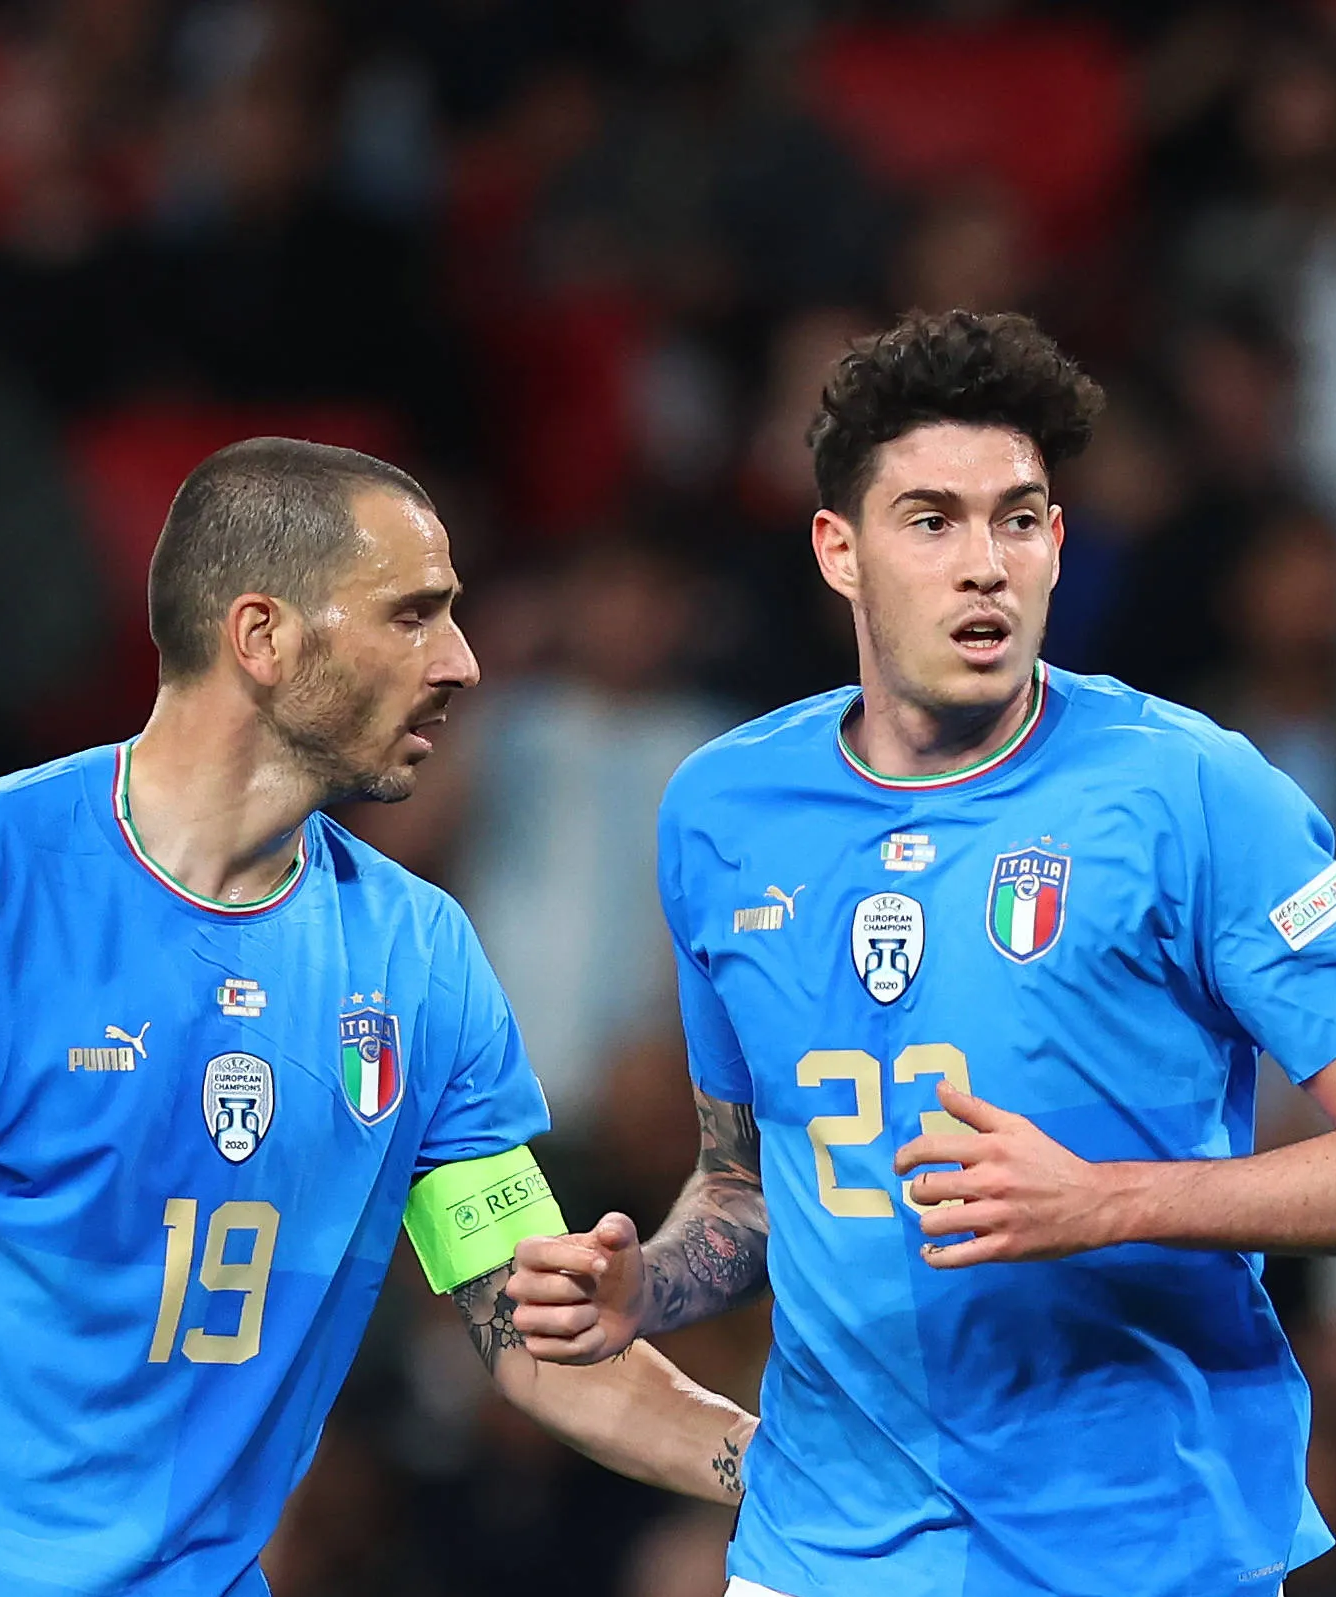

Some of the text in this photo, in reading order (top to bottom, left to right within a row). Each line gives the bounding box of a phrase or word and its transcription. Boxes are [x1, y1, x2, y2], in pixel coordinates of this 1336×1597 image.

[1000, 859, 1062, 879] ITALIA
[733, 904, 784, 934] PUMA
[863, 914, 913, 923] EUROPEAN
[1275, 900, 1300, 923] UEFA
[863, 924, 912, 932] CHAMPIONS
[873, 981, 899, 990] 2020
[68, 1047, 136, 1072] PUMA
[214, 1073, 262, 1083] EUROPEAN
[214, 1082, 262, 1092] CHAMPIONS
[796, 1043, 978, 1218] 23
[225, 1141, 249, 1150] 2020
[147, 1198, 281, 1365] 19
